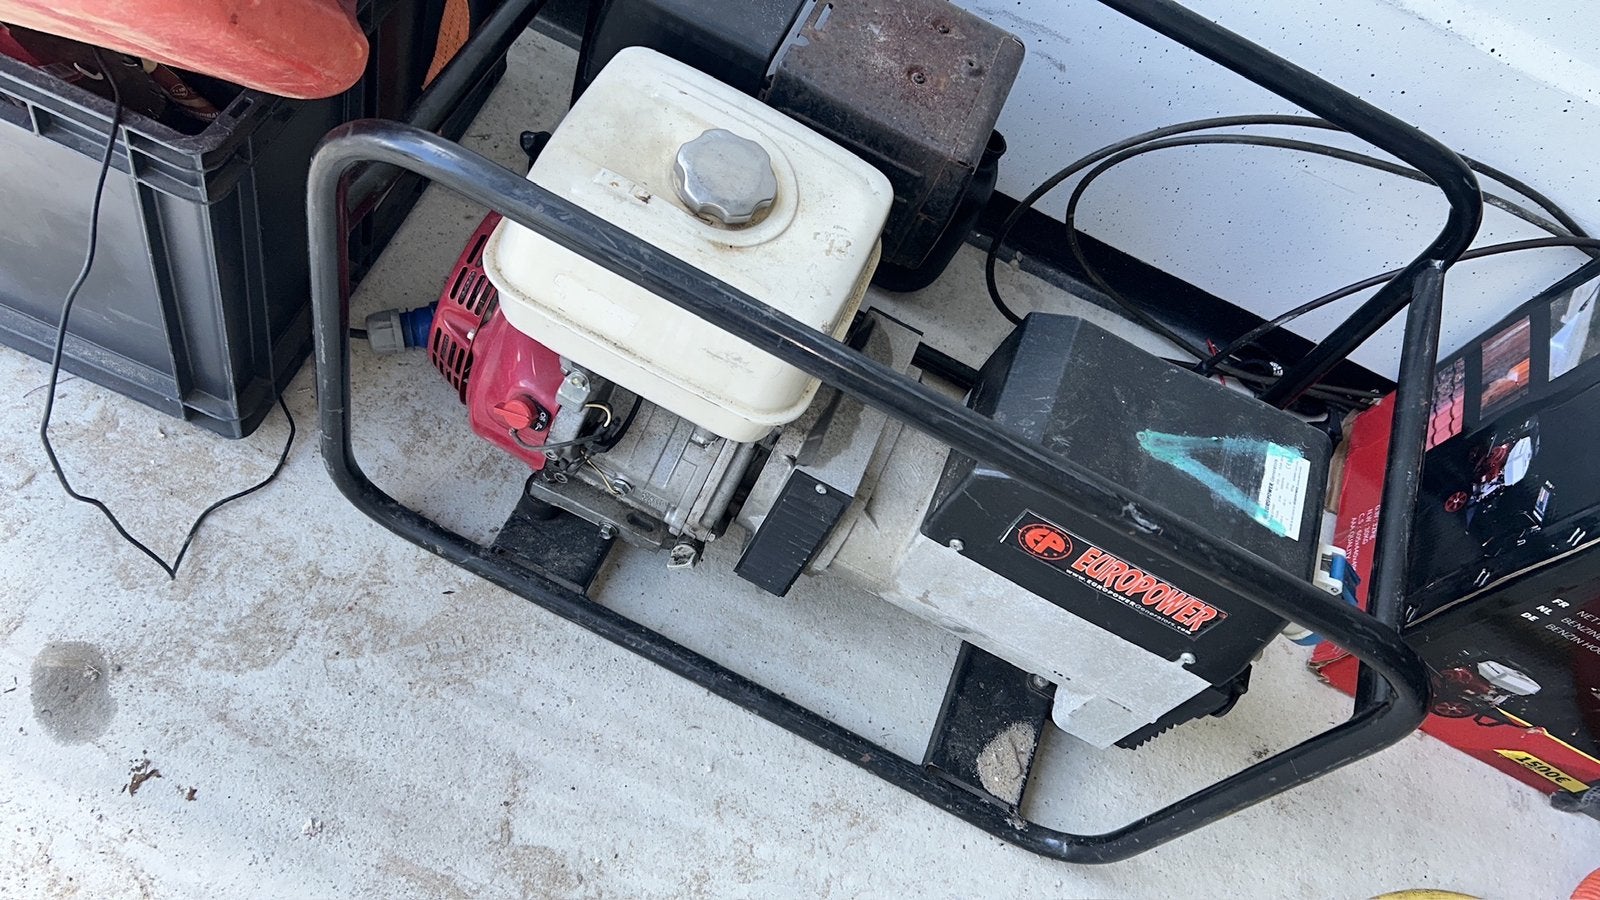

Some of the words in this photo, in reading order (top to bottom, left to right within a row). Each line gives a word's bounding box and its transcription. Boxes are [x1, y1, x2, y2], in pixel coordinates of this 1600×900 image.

[1071, 546, 1218, 632] EUROPOWER
[1536, 605, 1553, 616] NL
[1552, 598, 1570, 608] FR
[1577, 610, 1600, 625] NET
[1521, 612, 1540, 622] DE
[1545, 623, 1584, 644] BENZIN
